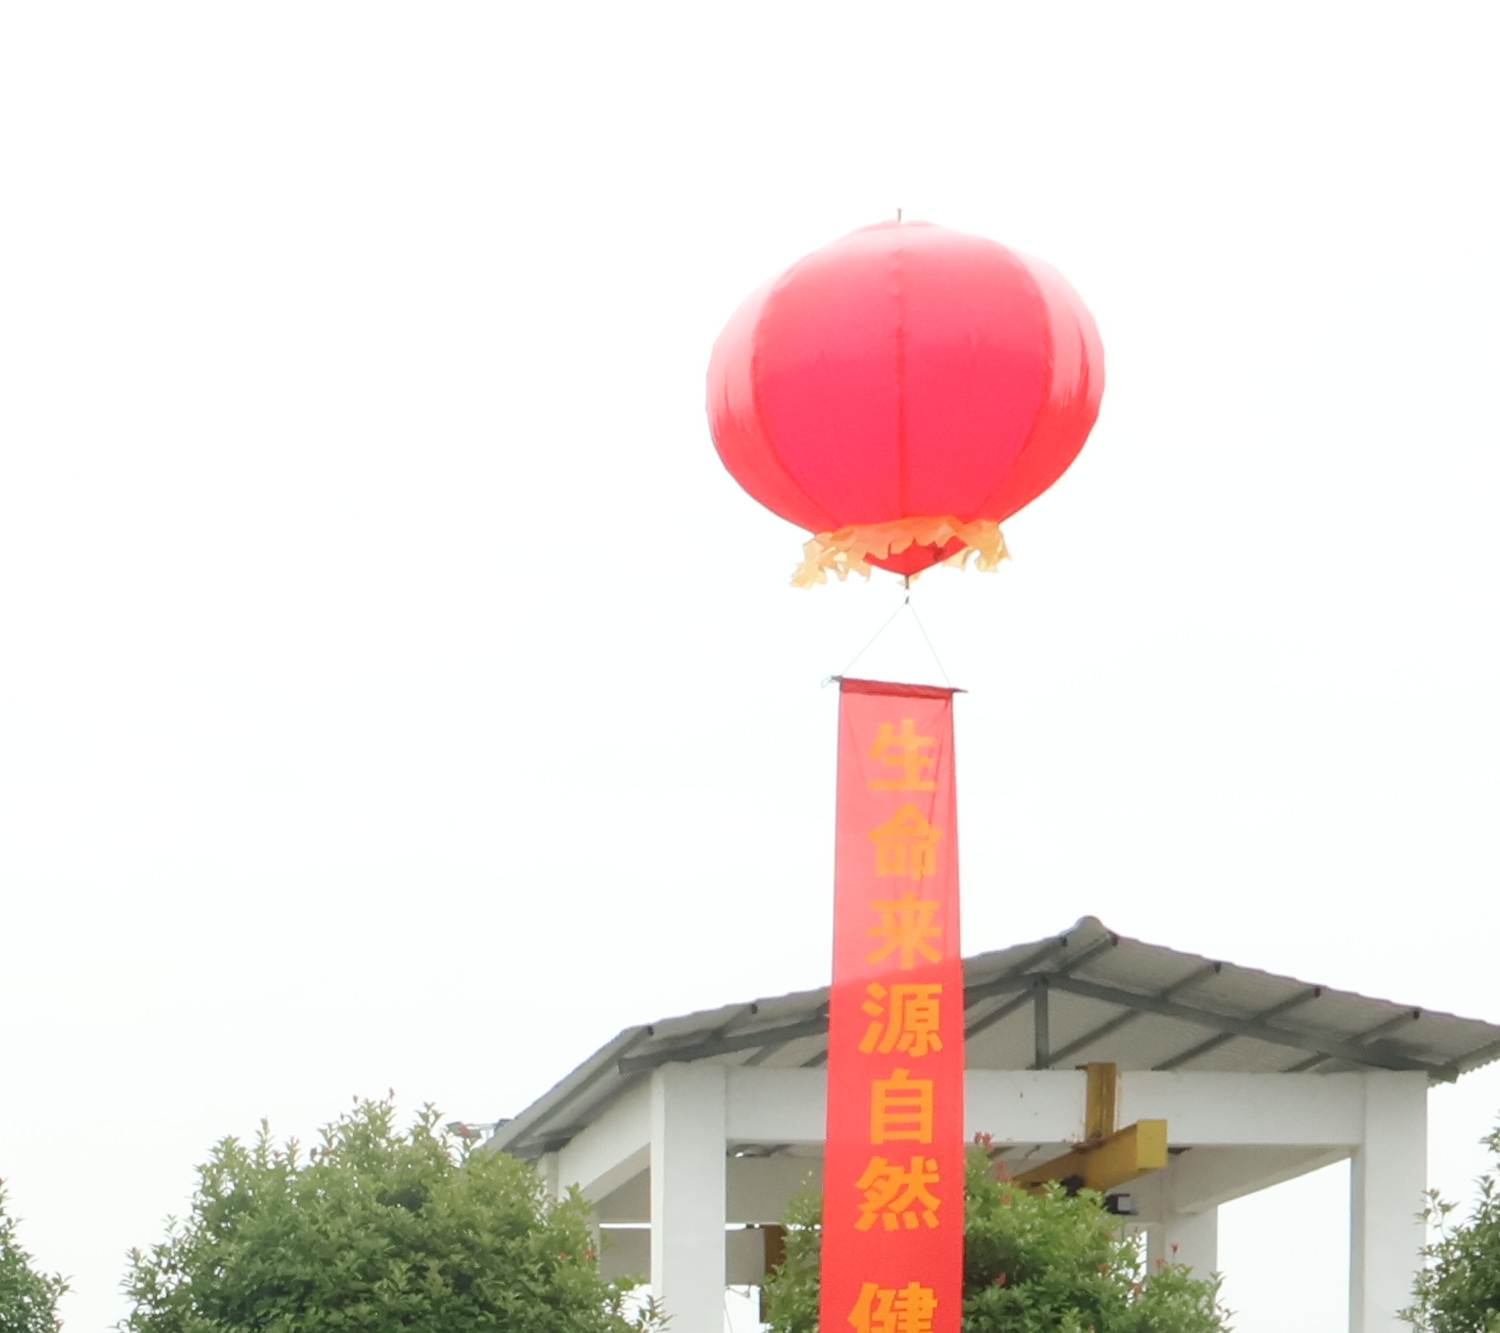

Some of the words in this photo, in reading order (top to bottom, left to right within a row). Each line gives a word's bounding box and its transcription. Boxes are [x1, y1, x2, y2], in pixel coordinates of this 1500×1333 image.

[853, 718, 944, 1232] 生命来源自然
